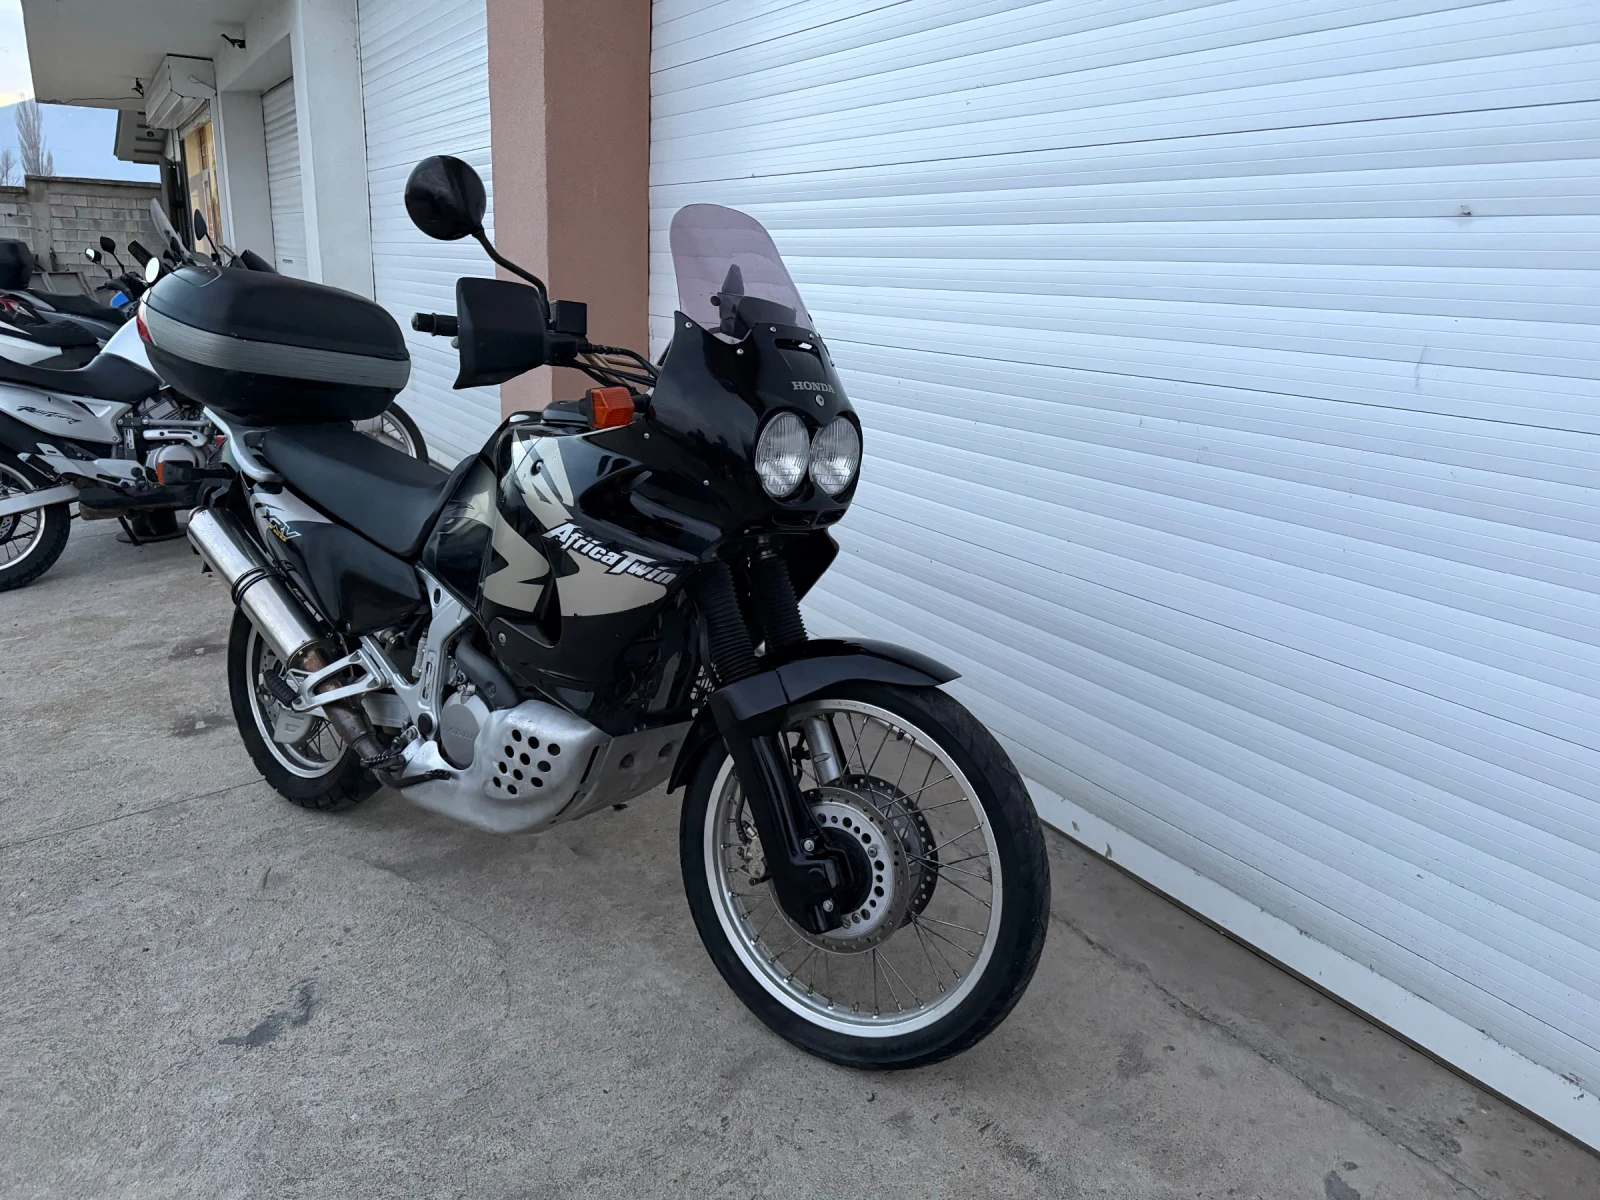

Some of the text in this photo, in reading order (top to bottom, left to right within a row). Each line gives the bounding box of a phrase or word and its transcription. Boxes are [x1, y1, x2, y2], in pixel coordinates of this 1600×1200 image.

[791, 381, 835, 393] HONDA
[261, 506, 302, 540] XRV
[542, 522, 677, 584] Africa Twin
